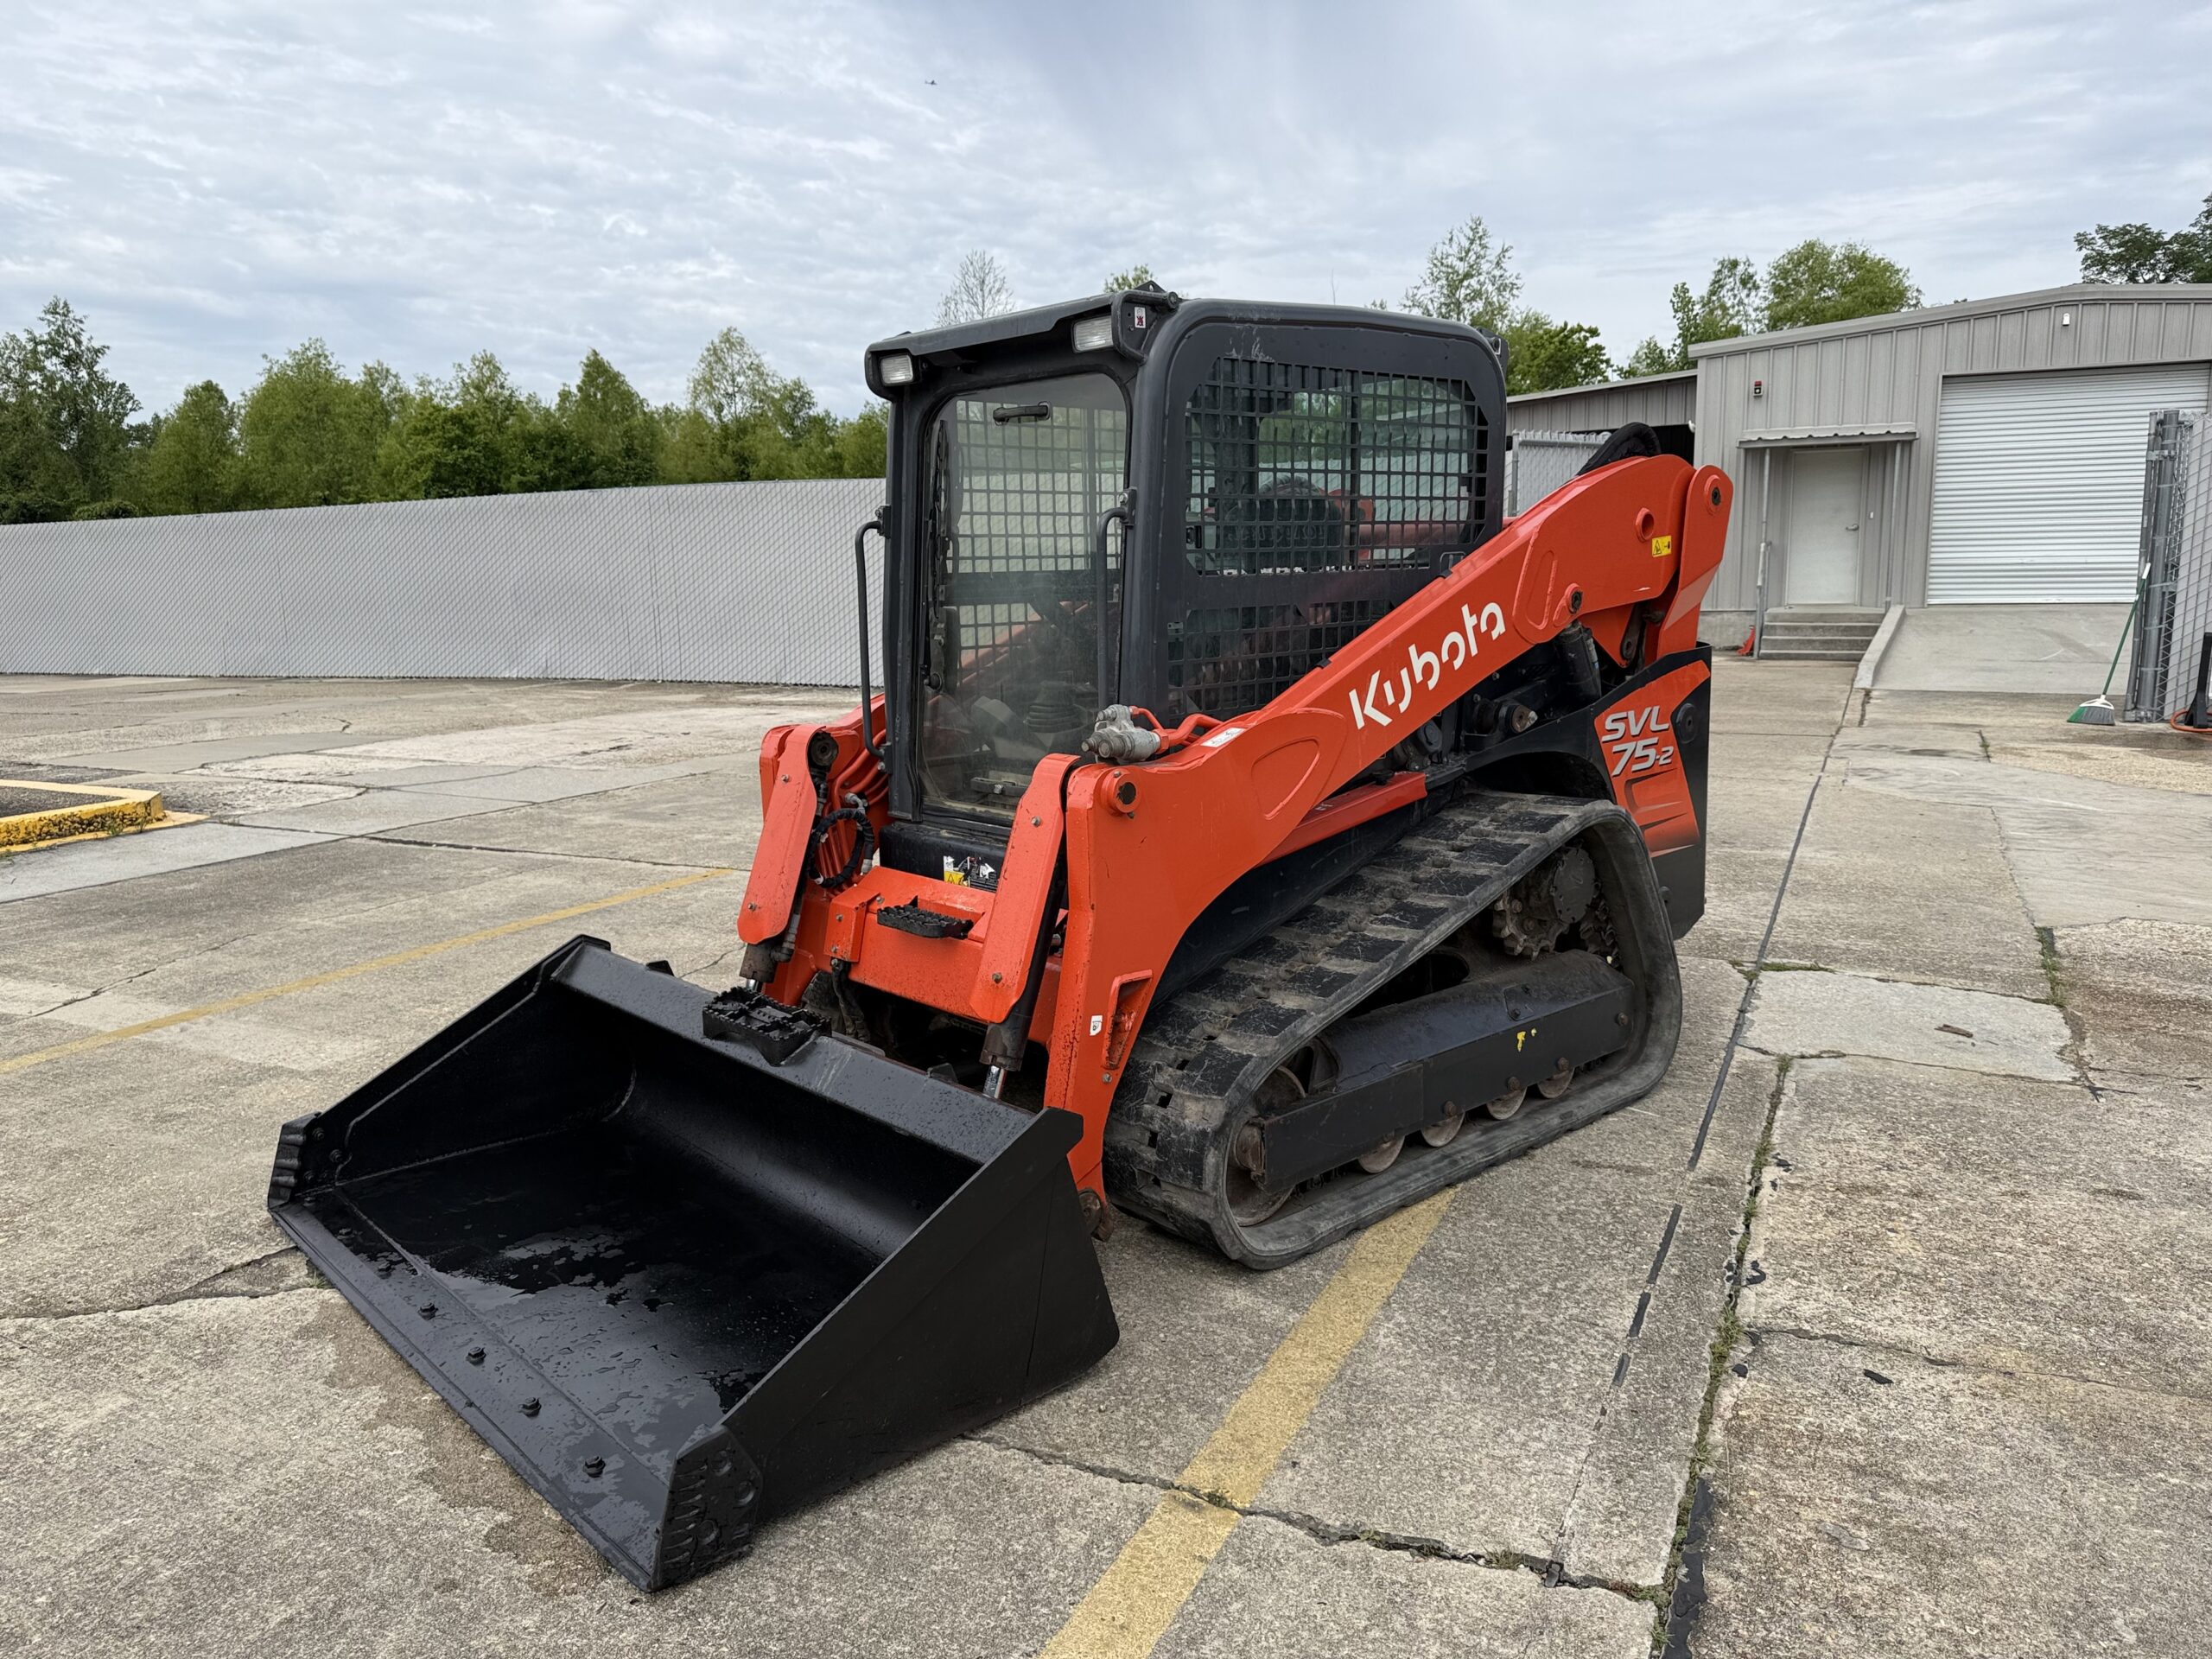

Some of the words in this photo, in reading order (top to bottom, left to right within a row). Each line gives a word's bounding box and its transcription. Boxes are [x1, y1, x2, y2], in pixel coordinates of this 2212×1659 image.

[1348, 601, 1506, 730] Kubota
[1601, 705, 1669, 742] SVL
[1611, 736, 1675, 777] 75-2
